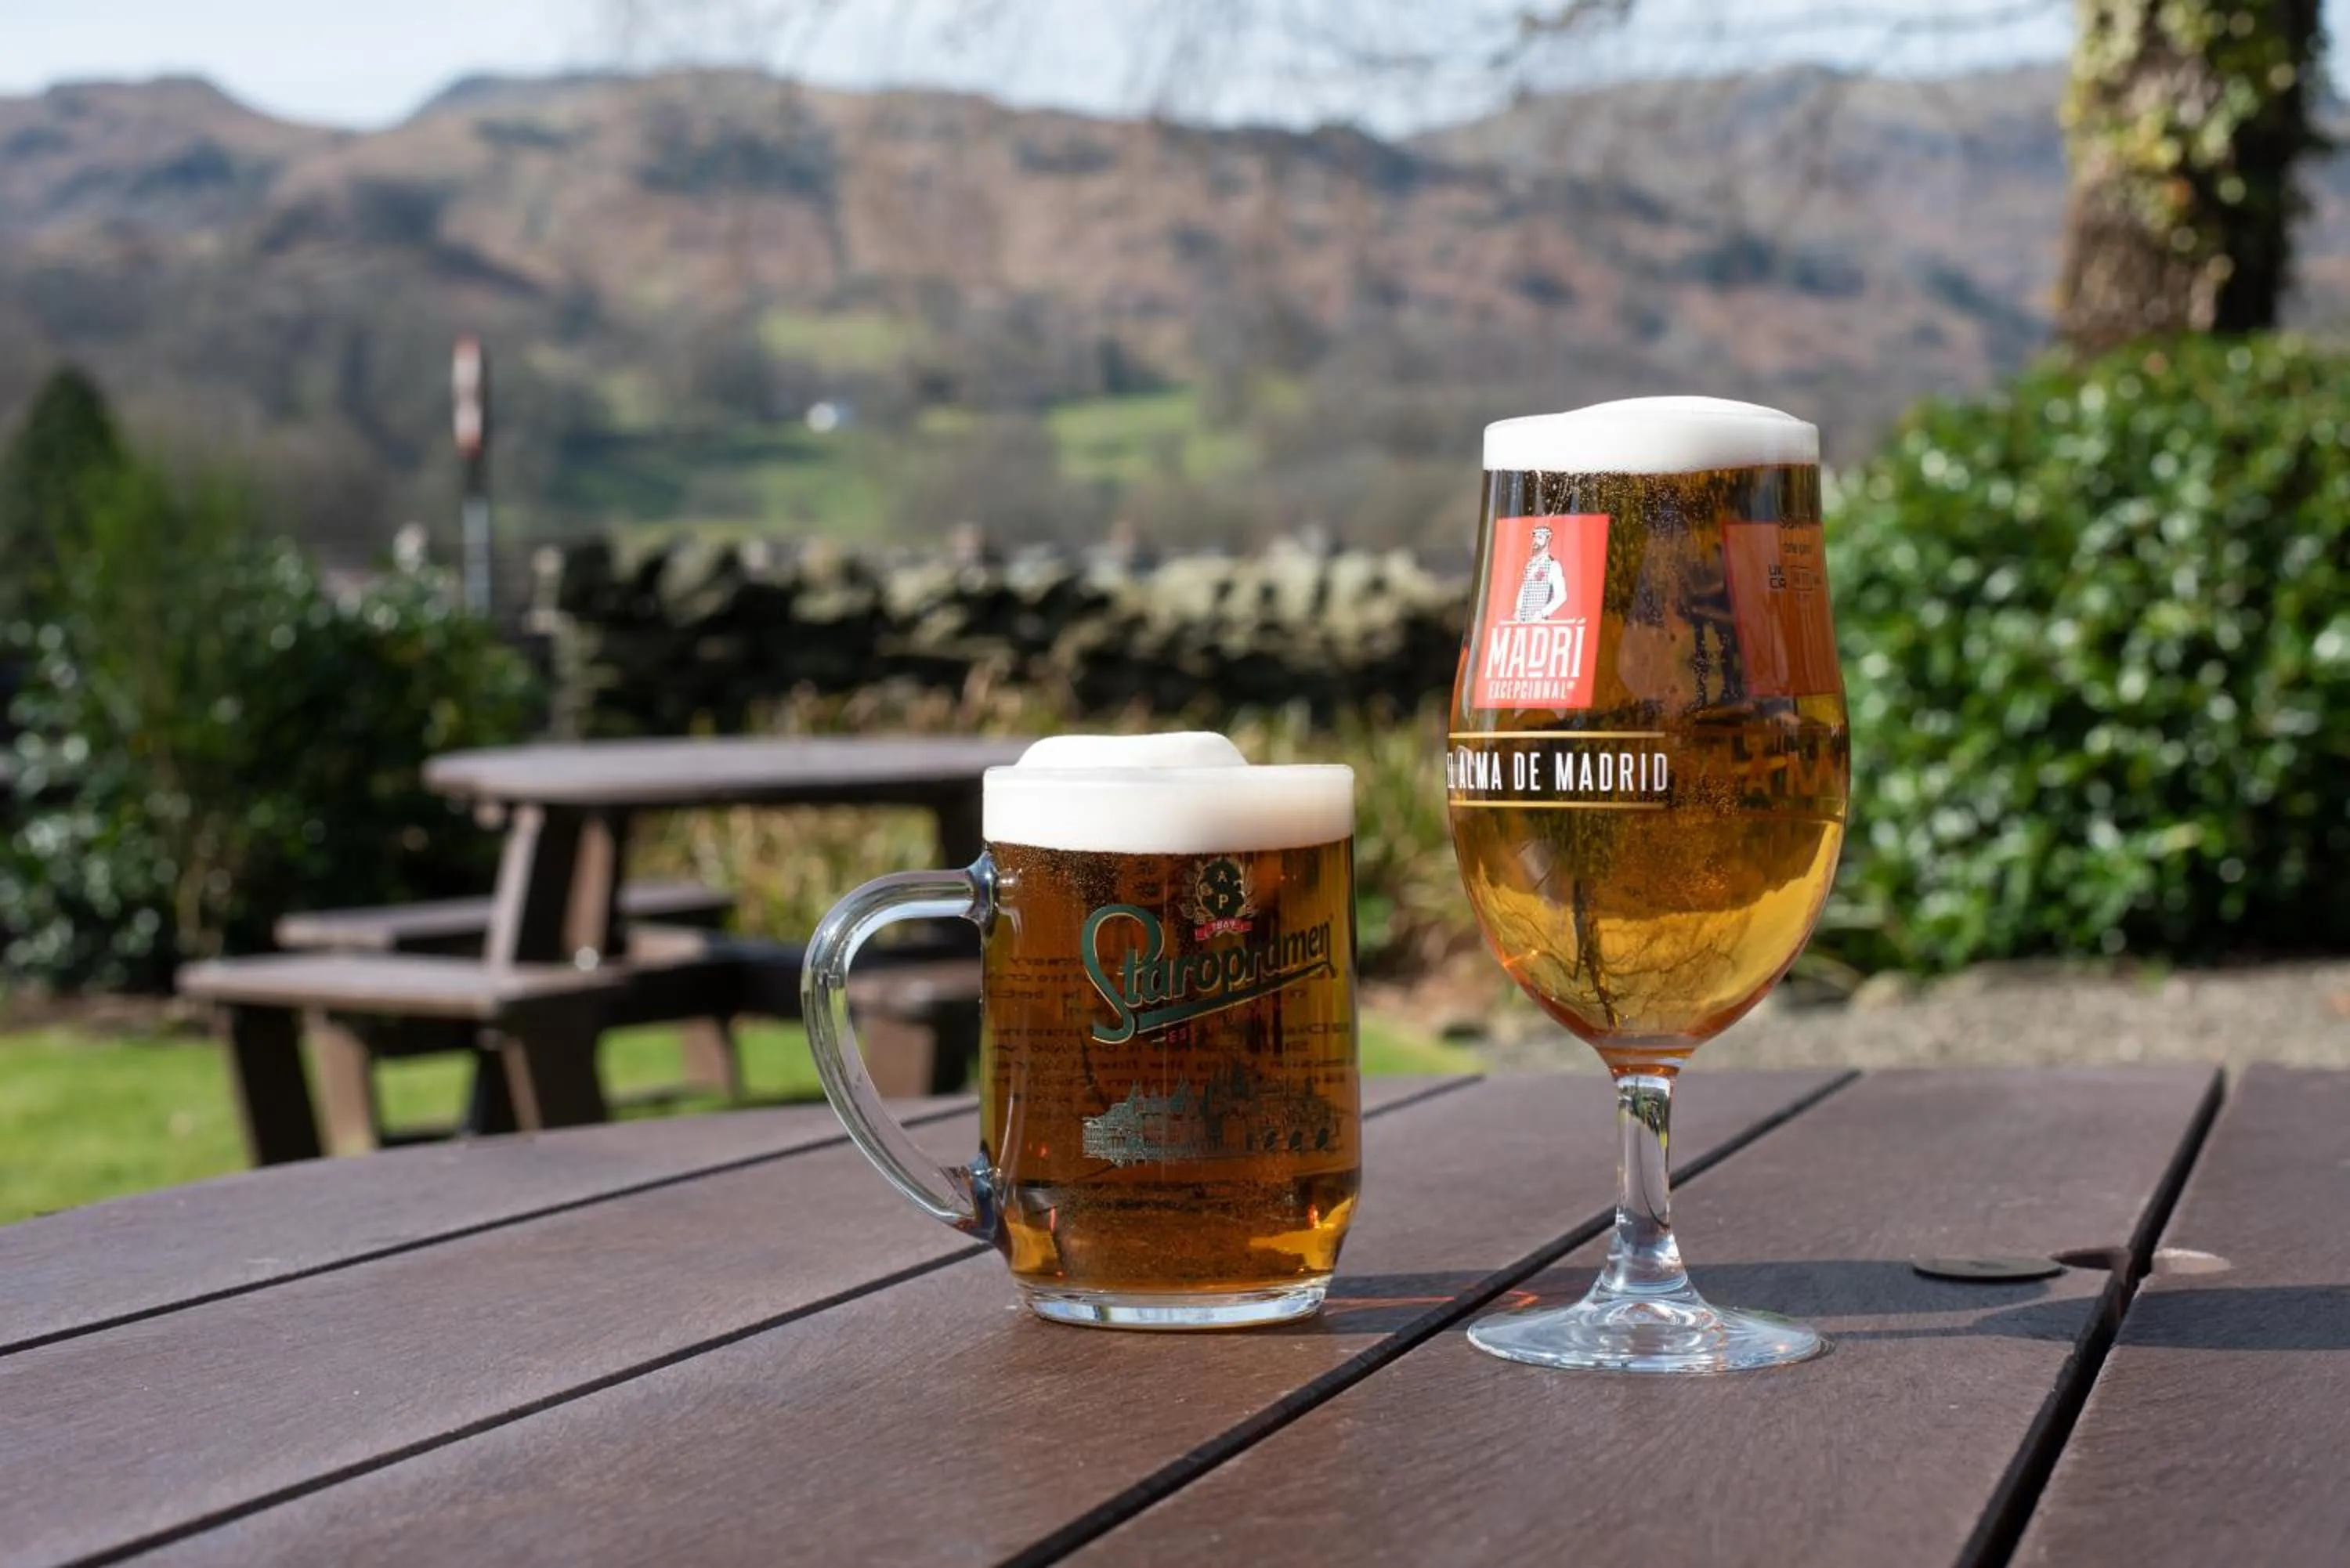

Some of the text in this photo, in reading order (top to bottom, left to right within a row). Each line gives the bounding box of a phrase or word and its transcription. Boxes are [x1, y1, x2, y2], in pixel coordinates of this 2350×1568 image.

[1484, 617, 1587, 679] MADRÍ
[1459, 751, 1503, 790] ALMA
[1513, 752, 1542, 791] DE
[1555, 752, 1668, 793] MADRID
[1217, 869, 1228, 883] A
[1218, 893, 1229, 909] P
[1081, 904, 1334, 1044] Staropramen
